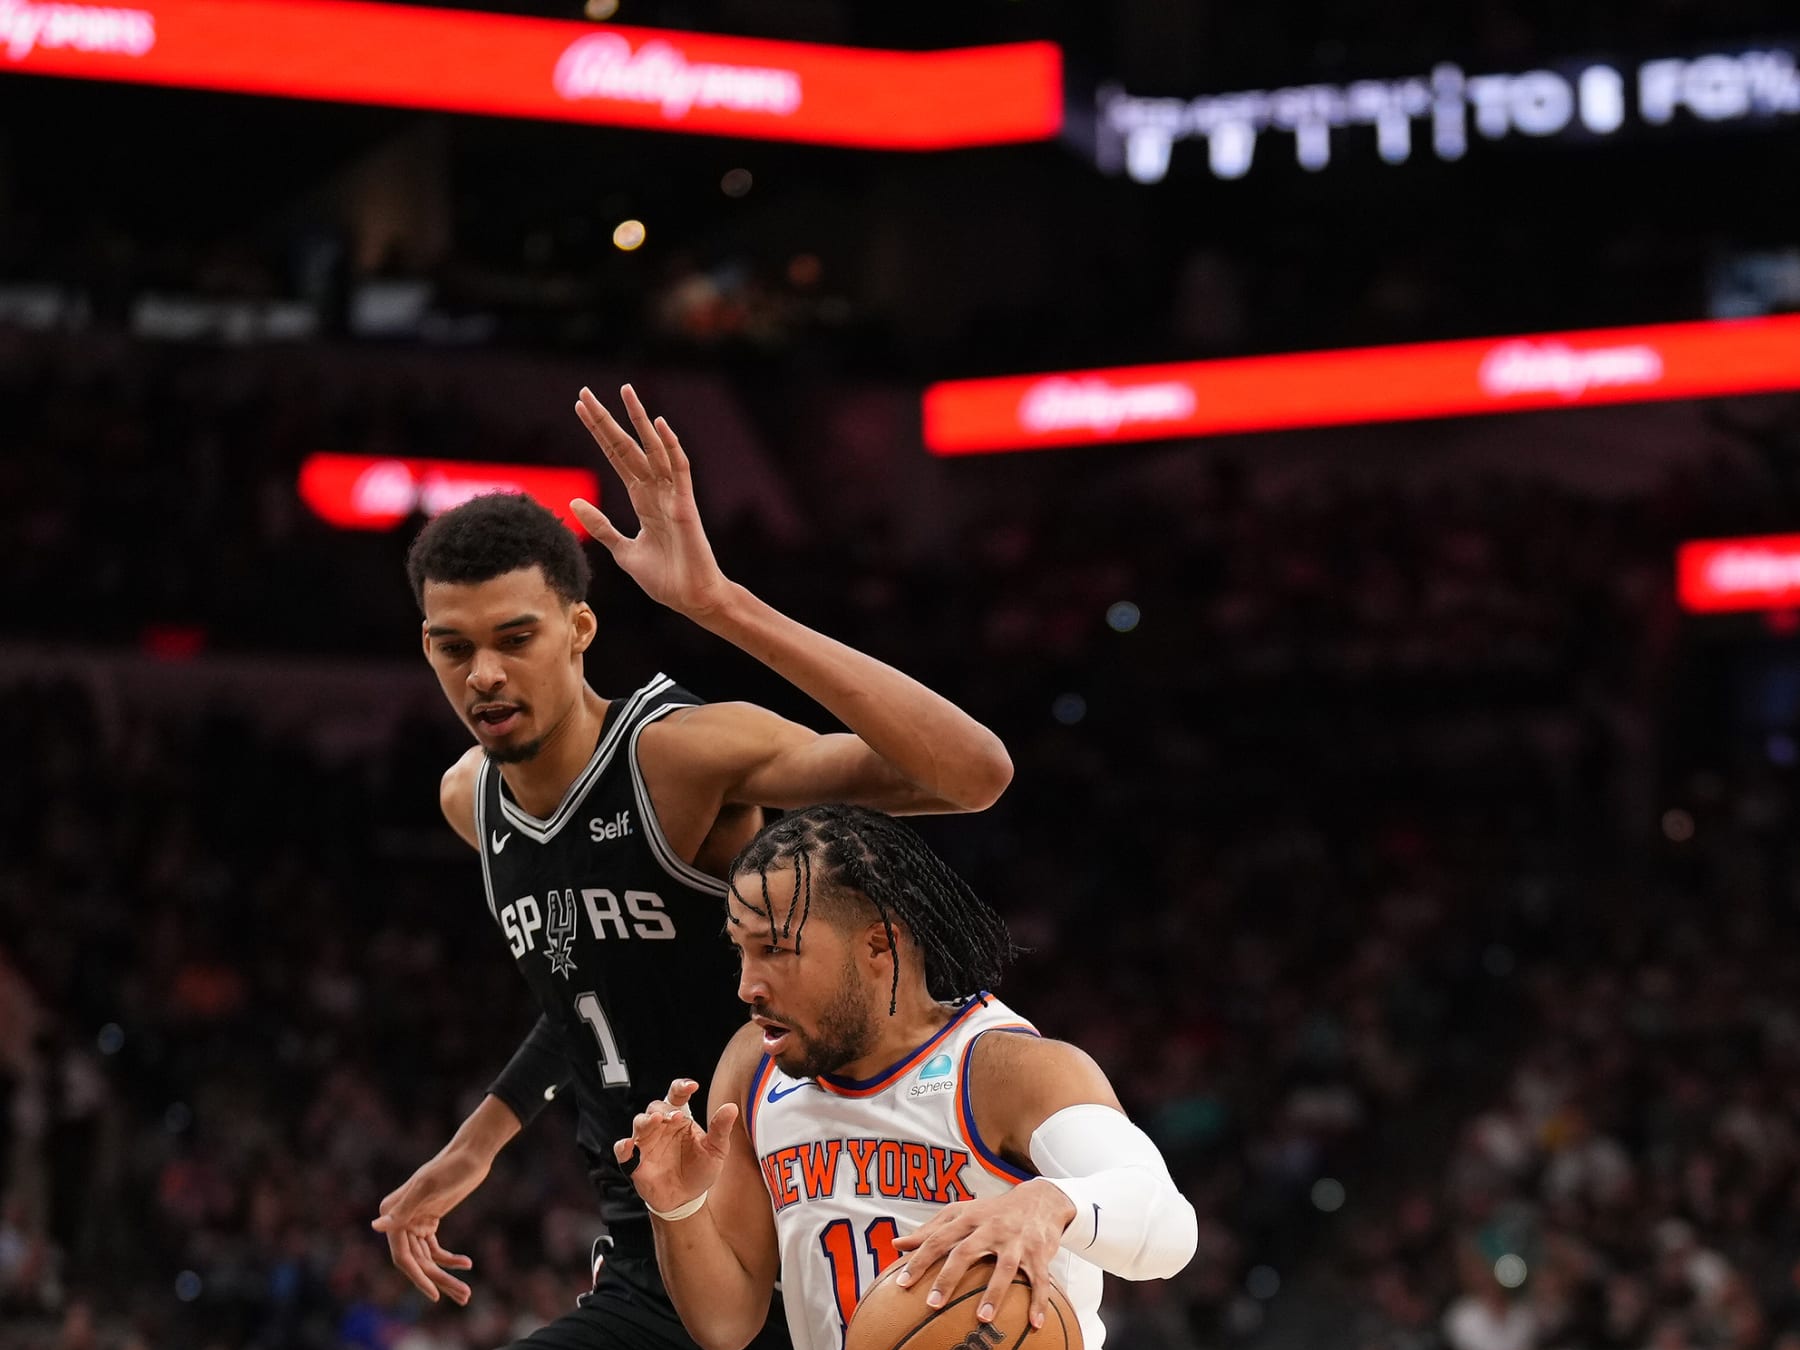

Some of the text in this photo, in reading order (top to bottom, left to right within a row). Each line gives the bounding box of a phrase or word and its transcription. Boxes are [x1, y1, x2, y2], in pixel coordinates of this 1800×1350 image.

[589, 810, 633, 842] Self.
[500, 888, 676, 980] SPURS
[574, 991, 631, 1088] 1
[910, 1080, 953, 1097] sphere
[761, 1137, 977, 1213] NEW YORK
